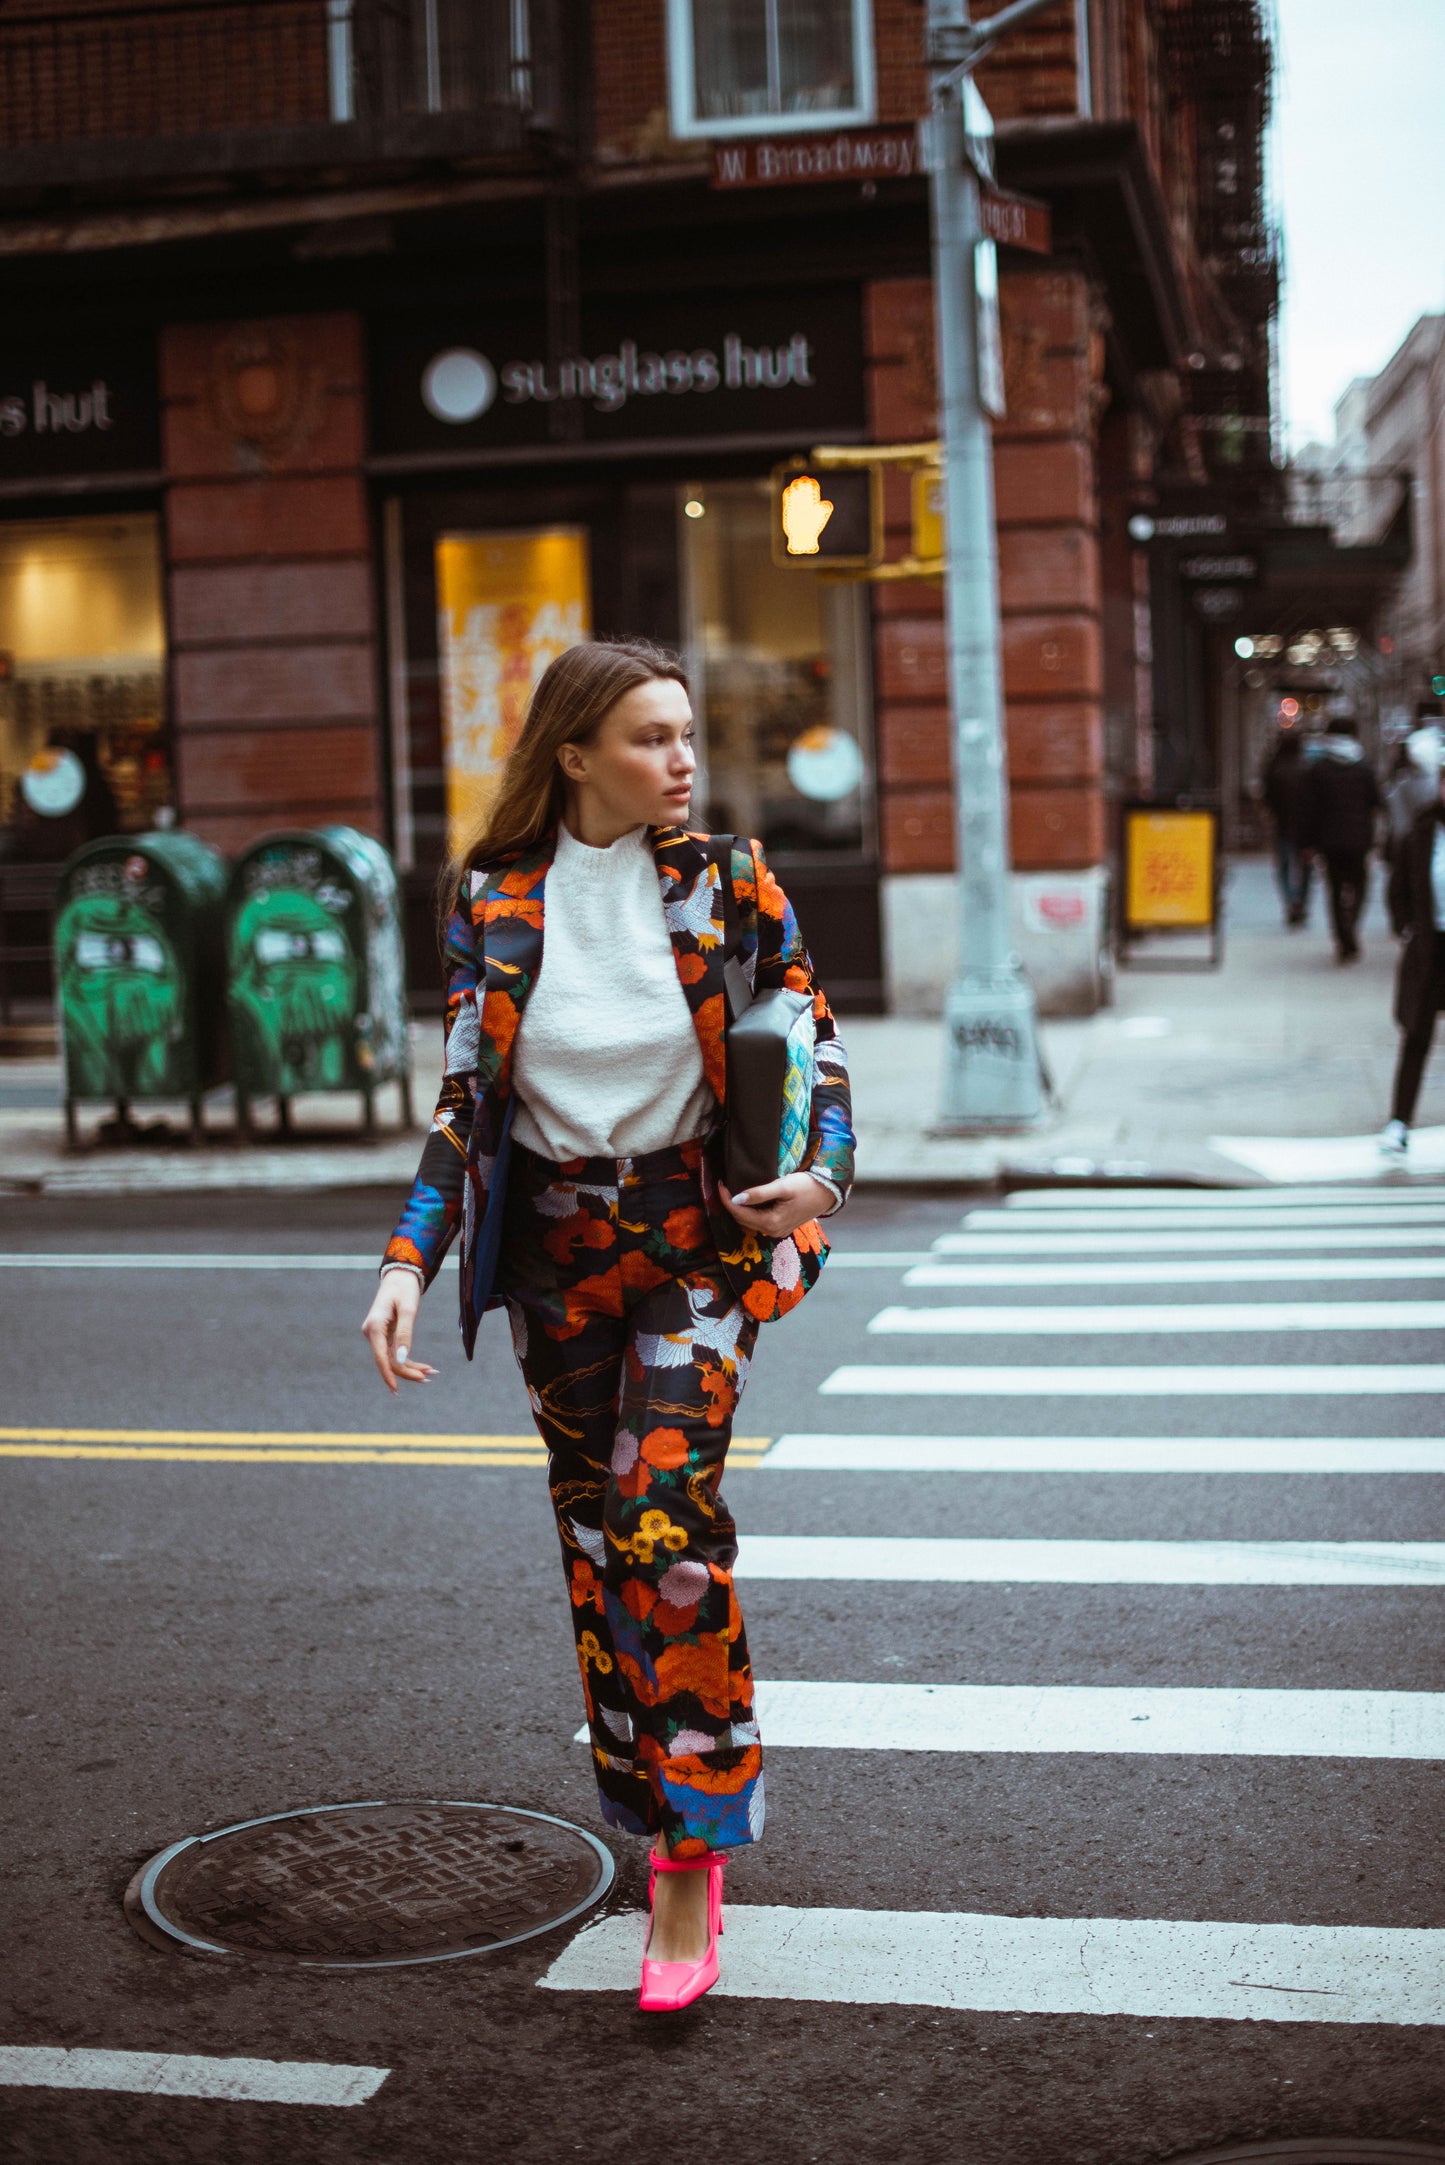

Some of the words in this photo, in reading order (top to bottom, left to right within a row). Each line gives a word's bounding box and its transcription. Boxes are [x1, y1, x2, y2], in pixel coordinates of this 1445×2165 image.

[756, 135, 914, 180] Broadway
[501, 338, 720, 412] sunglass
[724, 332, 816, 388] hut
[33, 379, 114, 434] hut
